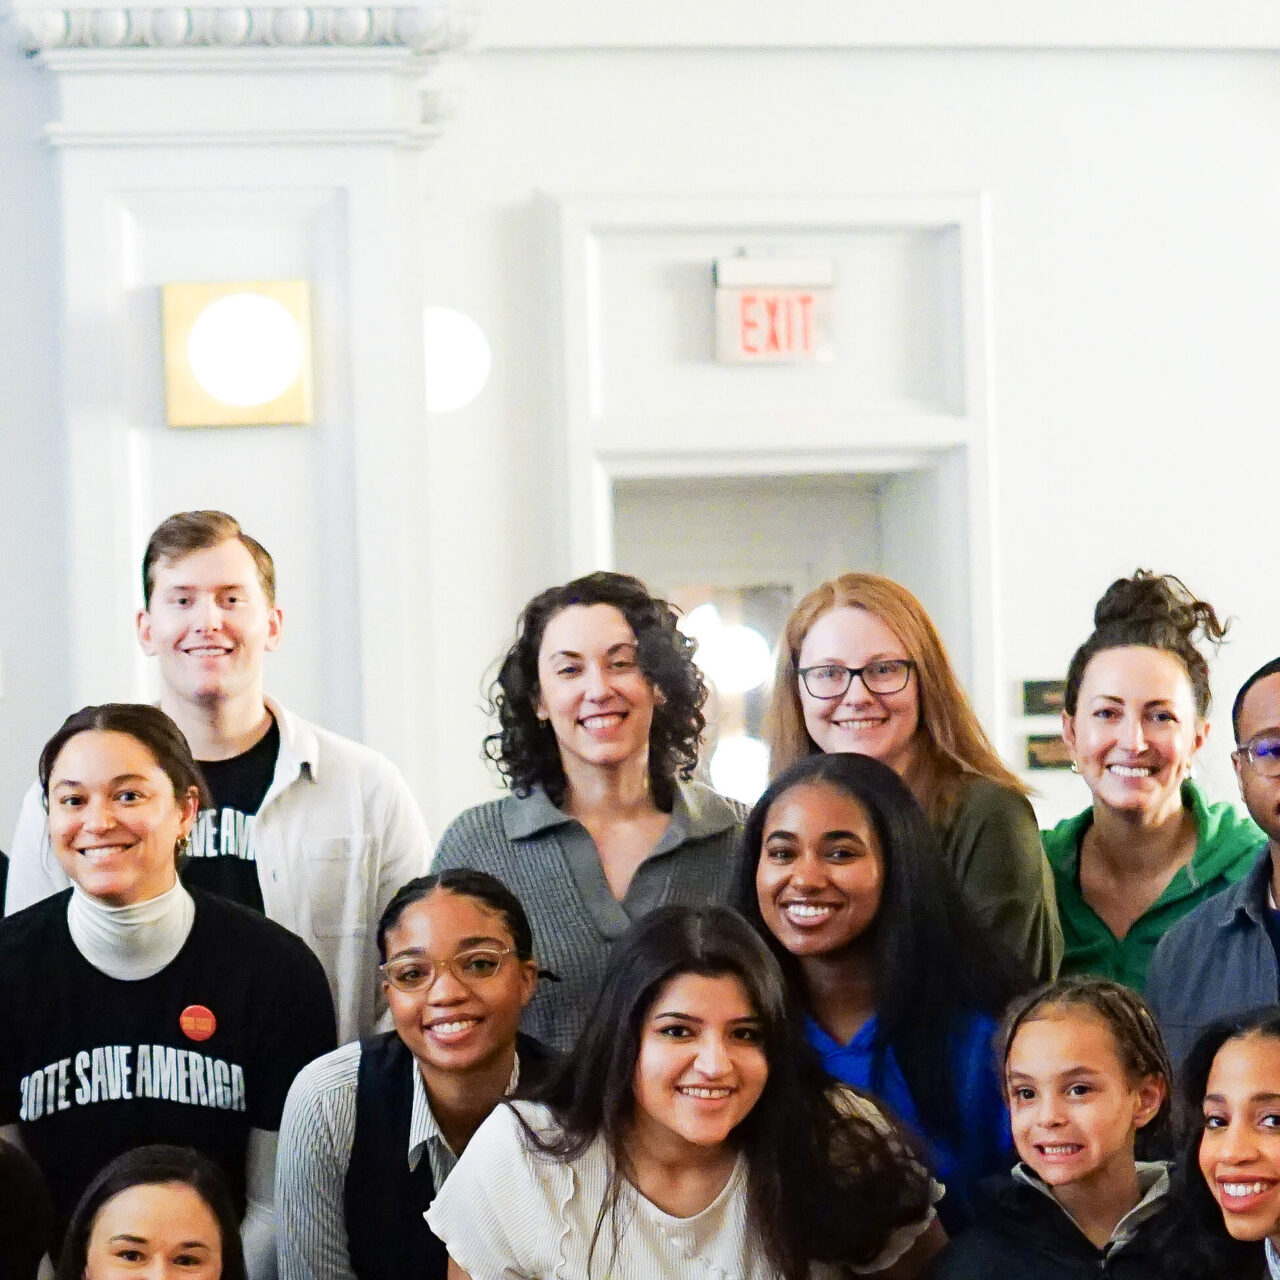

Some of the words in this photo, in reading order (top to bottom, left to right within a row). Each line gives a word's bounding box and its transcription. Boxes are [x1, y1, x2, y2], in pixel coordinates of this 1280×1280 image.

[740, 295, 815, 354] EXIT
[74, 1045, 134, 1106] SAVE
[135, 1044, 247, 1113] AMERICA
